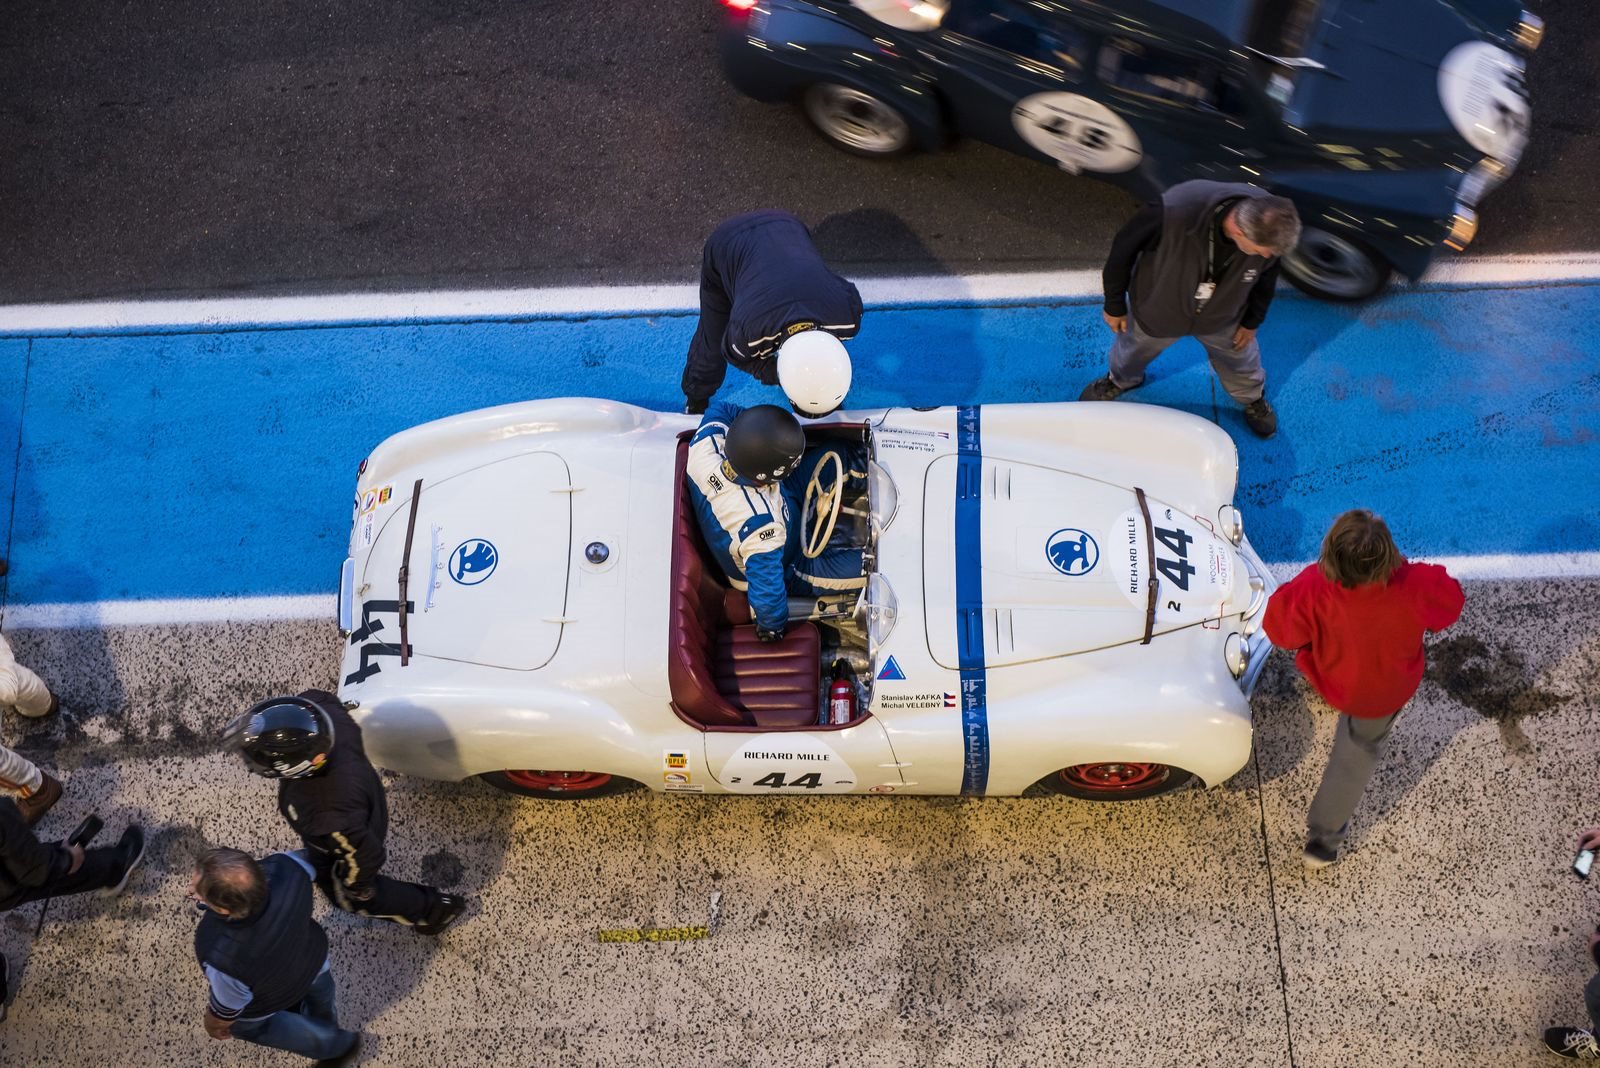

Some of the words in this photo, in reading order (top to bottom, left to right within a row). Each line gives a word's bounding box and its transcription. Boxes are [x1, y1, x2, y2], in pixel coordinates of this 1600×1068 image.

[709, 474, 725, 492] OMP
[759, 529, 776, 540] OMP
[1127, 516, 1137, 545] MILLE
[1154, 526, 1196, 592] 44
[1207, 543, 1217, 584] WOODHAM
[1129, 548, 1139, 594] RICHARD
[1167, 600, 1181, 613] 2
[344, 600, 415, 687] 44
[744, 751, 793, 761] RICHARD
[797, 752, 830, 762] MILLE
[752, 772, 823, 789] 44
